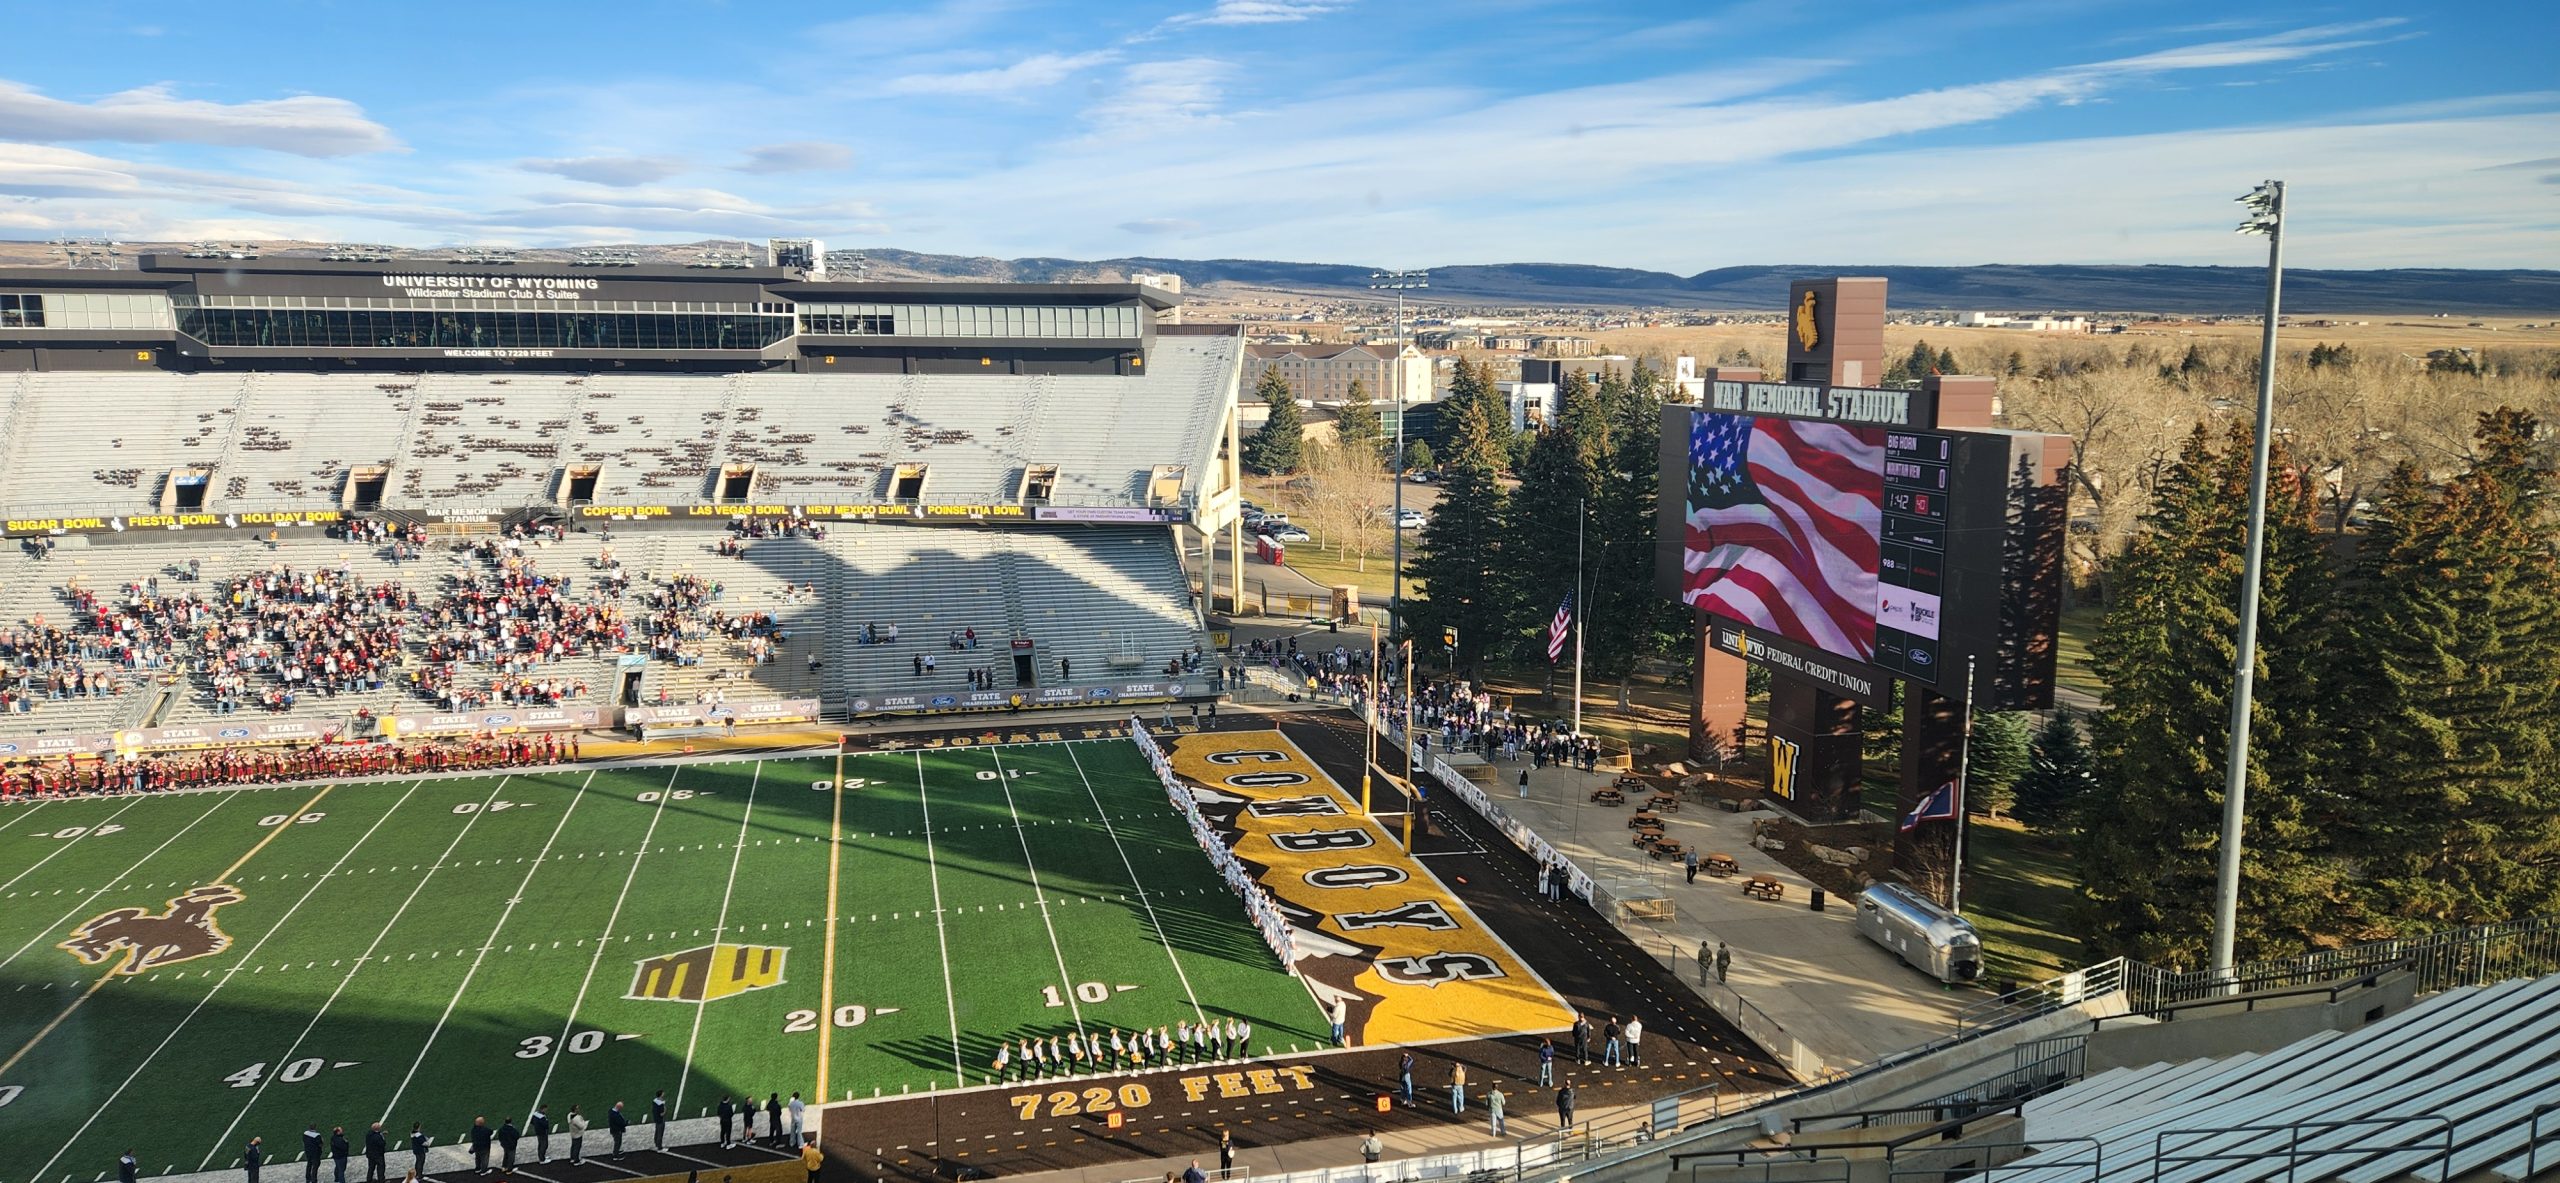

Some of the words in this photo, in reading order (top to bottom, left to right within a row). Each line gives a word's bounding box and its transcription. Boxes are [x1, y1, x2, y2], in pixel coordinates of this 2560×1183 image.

[383, 275, 485, 287] UNIVERSITY
[491, 277, 513, 288] OF
[518, 278, 599, 289] WYOMING
[405, 288, 459, 298] Wildcatter
[463, 288, 506, 298] Stadium
[509, 289, 532, 299] Club
[536, 291, 544, 299] &
[546, 290, 579, 300] Suites
[1713, 381, 1743, 410] WAR
[1747, 384, 1823, 417] MEMORIAL
[1827, 388, 1910, 424] STADIUM
[1888, 435, 1899, 449] BIG
[1899, 437, 1917, 451] HORN
[1940, 440, 1948, 460] 0
[1938, 469, 1946, 488] 0
[426, 508, 449, 516] WAR
[451, 508, 505, 516] MEMORIAL
[582, 507, 634, 516] COPPER
[636, 506, 671, 516] BOWL
[689, 506, 712, 515] LAS
[714, 506, 753, 515] VEGAS
[756, 505, 789, 515] BOWL
[806, 506, 831, 515] NEW
[834, 506, 875, 515] MEXICO
[878, 505, 910, 515] BOWL
[927, 506, 990, 515] POINSETTIA
[994, 506, 1024, 515] BOWL
[129, 516, 175, 527] FIESTA
[179, 514, 220, 525] BOWL
[242, 512, 305, 523] HOLIDAY
[306, 511, 343, 522] BOWL
[443, 515, 488, 523] STADIUM
[7, 520, 58, 531] SUGAR
[63, 518, 105, 529] BOWL
[1883, 558, 1895, 568] 988
[1915, 607, 1935, 619] BUCKLE
[1767, 647, 1804, 671] FEDERAL
[1805, 660, 1837, 684] CREDIT
[1839, 672, 1872, 696] UNION
[1044, 688, 1073, 697] STATE
[1126, 684, 1155, 692] STATE
[885, 697, 916, 705] STATE
[971, 692, 1001, 701] STATE
[657, 708, 690, 717] STATE
[751, 704, 782, 712] STATE
[432, 716, 467, 725] STATE
[529, 711, 564, 720] STATE
[162, 728, 200, 738] STATE
[267, 723, 305, 732] STATE
[37, 738, 75, 748] STATE
[1772, 735, 1800, 801] W
[975, 768, 1023, 781] 10
[811, 778, 865, 791] 20
[637, 789, 694, 802] 30
[451, 800, 517, 815] 40
[257, 812, 326, 827] 50
[53, 825, 125, 839] 40
[1205, 749, 1508, 988] COWBOYS
[1040, 981, 1109, 1008] 10
[783, 1004, 868, 1034] 20
[515, 1030, 606, 1060] 30
[223, 1057, 326, 1089] 40
[1010, 1083, 1151, 1120] 7220
[1180, 1064, 1315, 1103] FEET
[1109, 1114, 1121, 1126] 10
